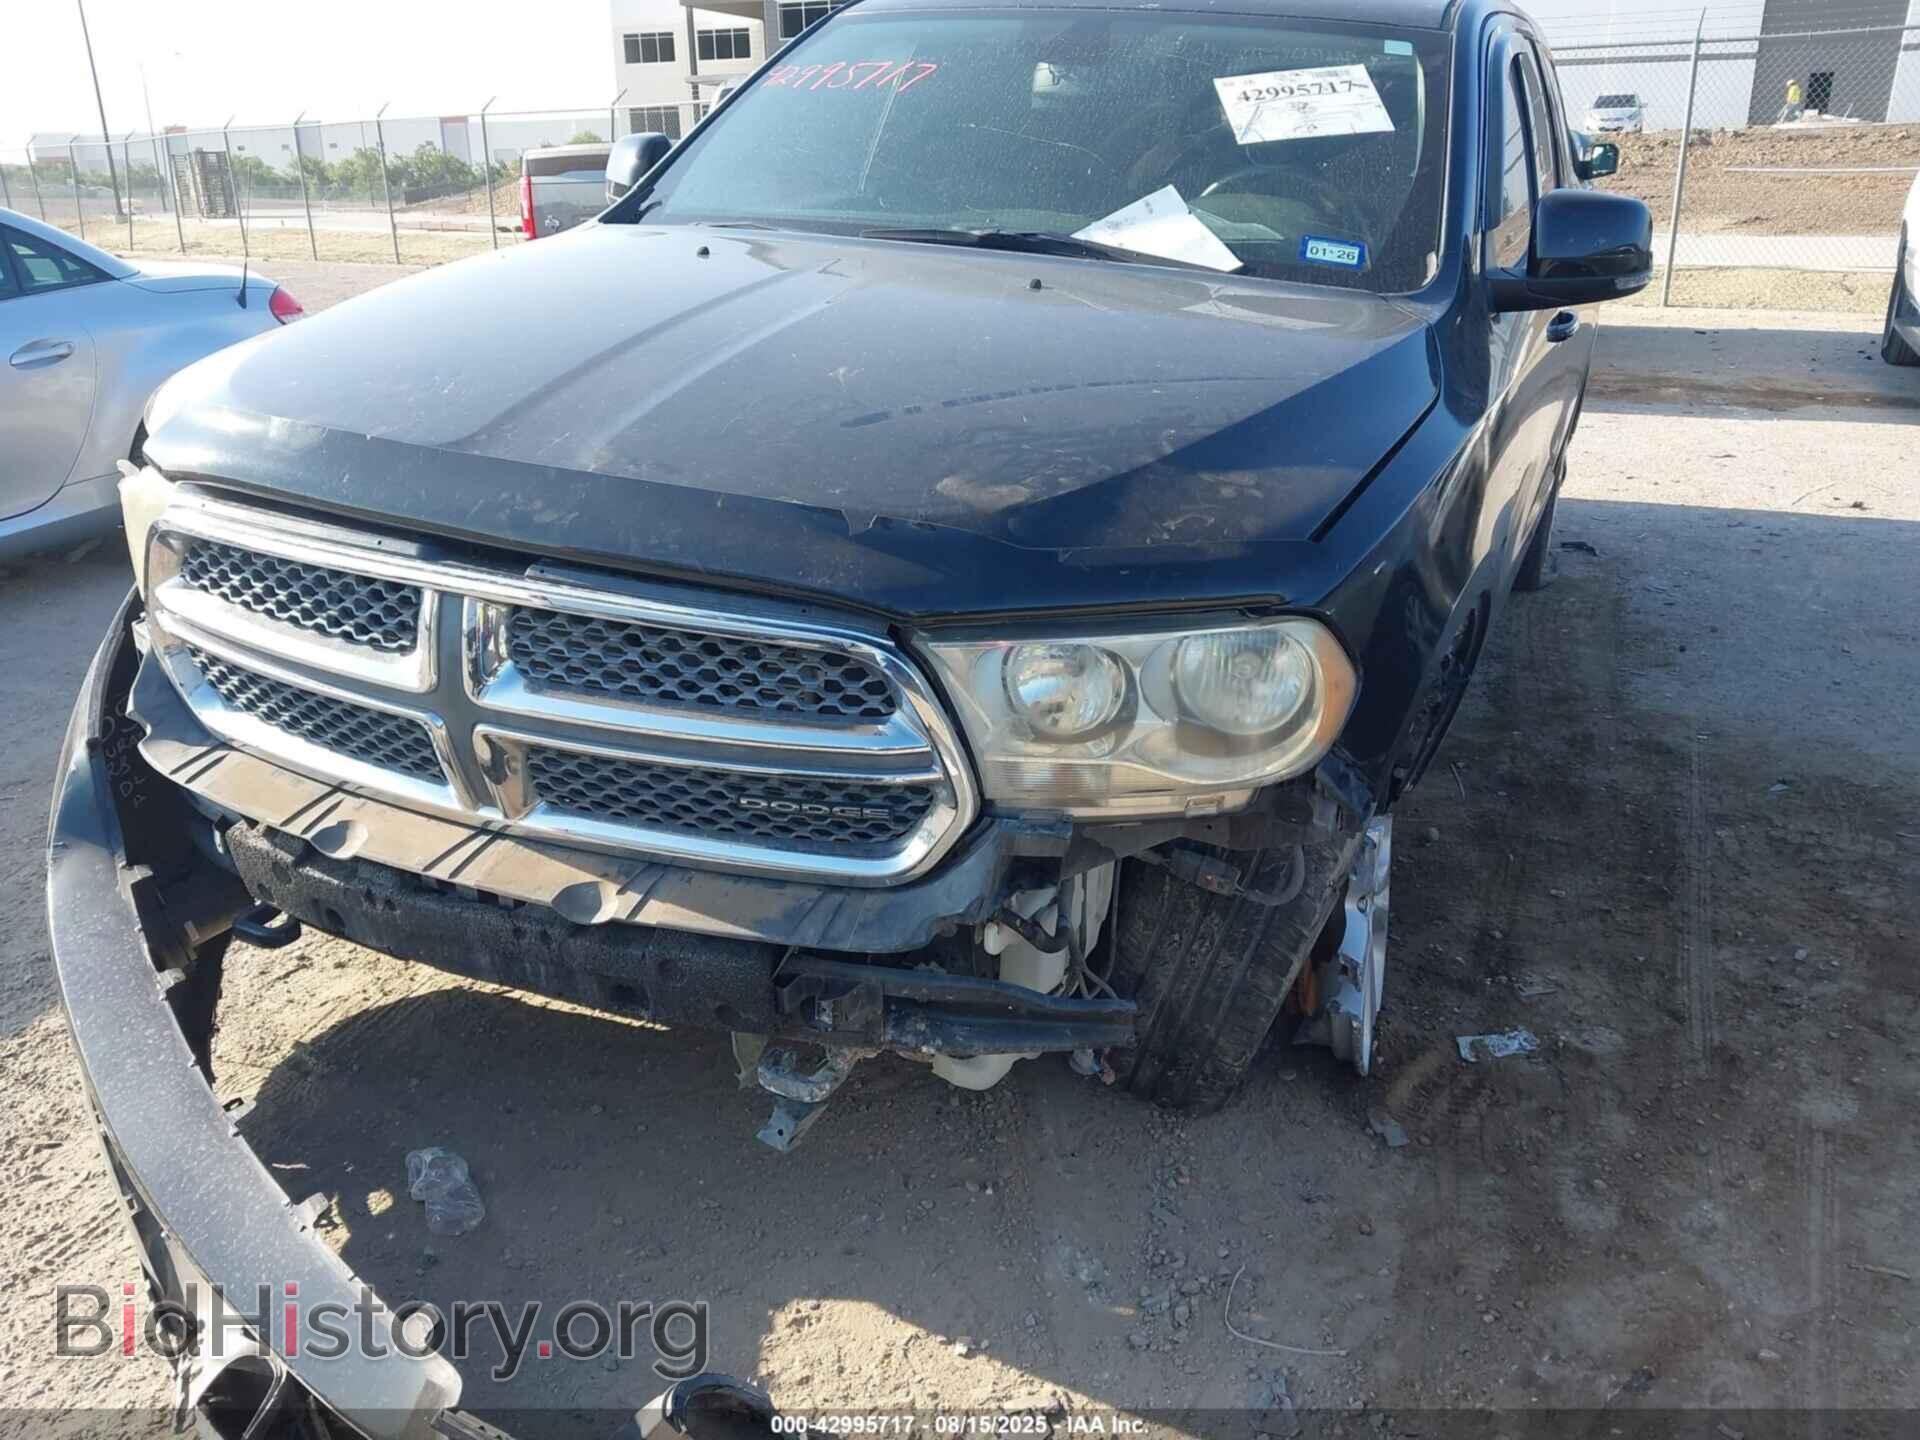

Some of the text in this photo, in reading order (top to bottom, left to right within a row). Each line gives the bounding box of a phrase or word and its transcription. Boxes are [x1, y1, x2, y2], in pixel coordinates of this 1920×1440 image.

[1236, 79, 1352, 103] 42995717
[1310, 246, 1356, 261] 01 26
[739, 798, 889, 818] DODGE
